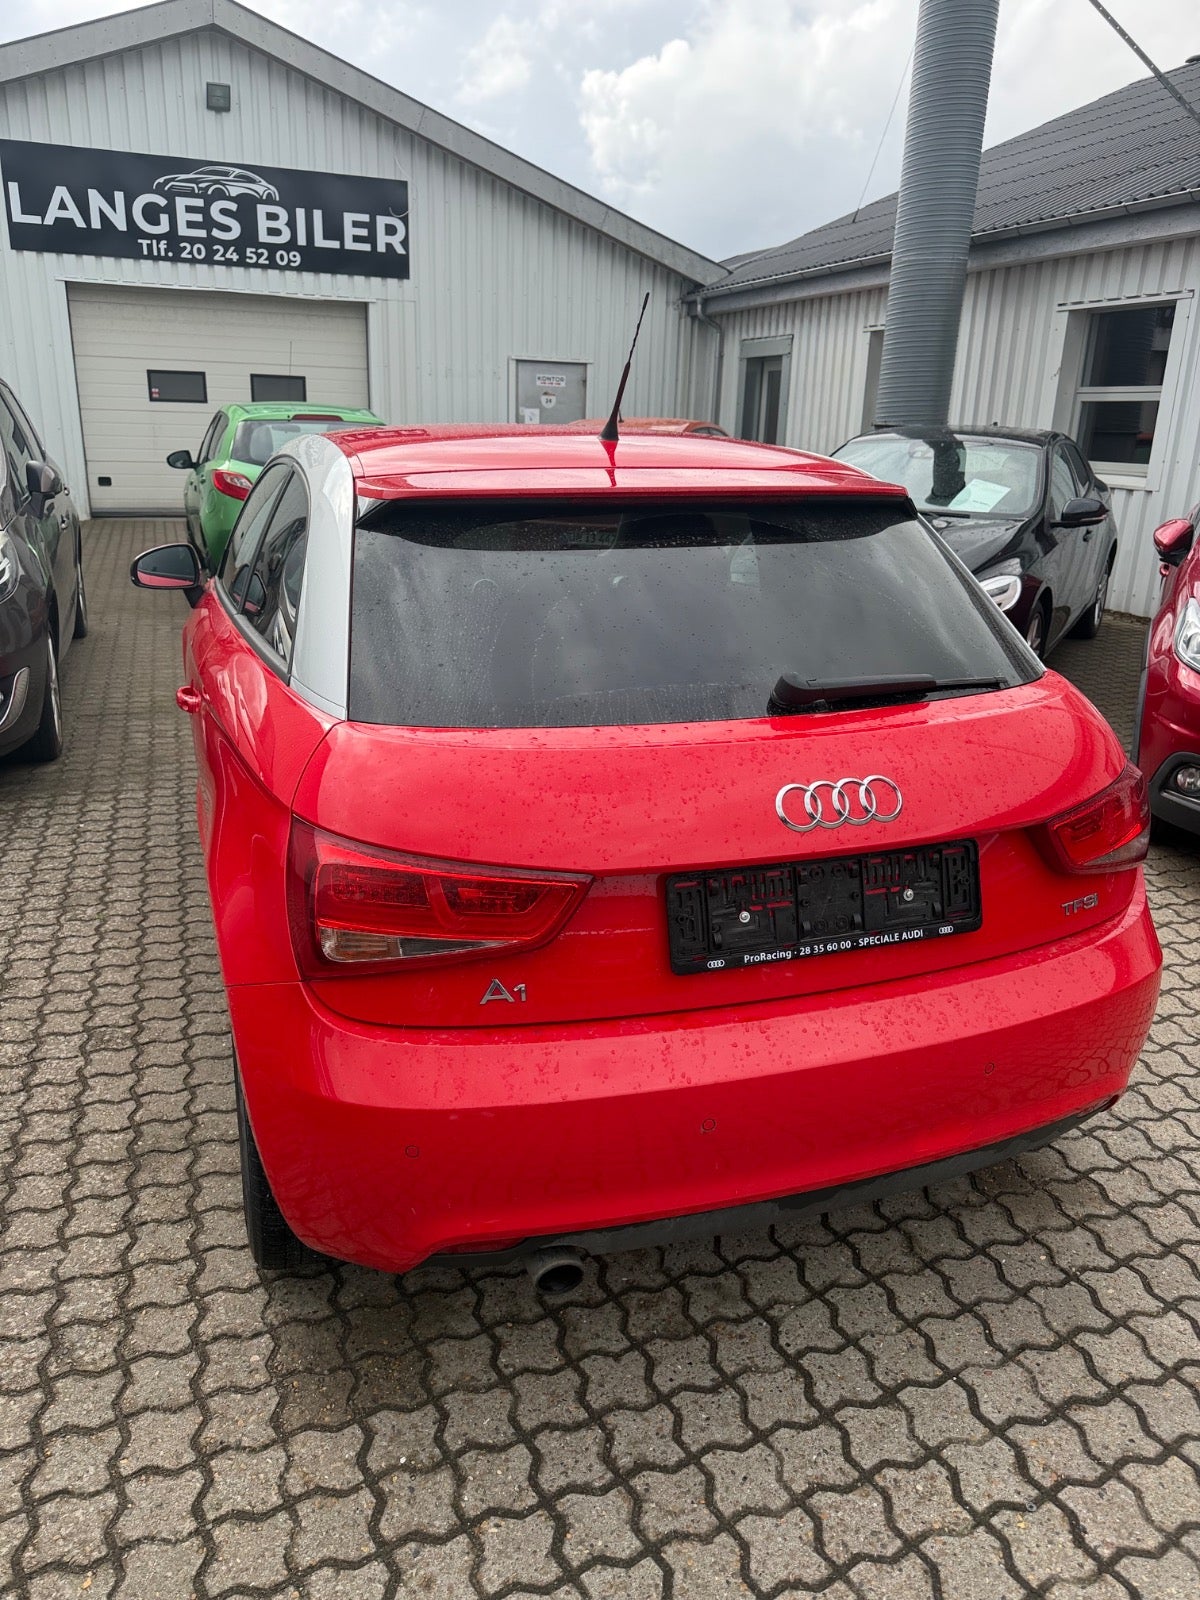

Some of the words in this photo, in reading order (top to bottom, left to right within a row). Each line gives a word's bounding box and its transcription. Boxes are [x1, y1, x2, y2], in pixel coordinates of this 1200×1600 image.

[8, 181, 242, 241] LANGES
[256, 203, 407, 255] BILER
[137, 239, 173, 257] Tlf.
[179, 242, 206, 260] 20
[212, 245, 239, 262] 24
[246, 247, 270, 265] 52
[275, 250, 301, 267] 09
[744, 950, 792, 964] ProRacing
[799, 946, 811, 956] 28
[814, 944, 825, 954] 35
[826, 942, 838, 952] 60
[840, 940, 851, 950] 00
[858, 932, 900, 947] SPECIALE
[901, 929, 923, 941] AUDI
[479, 978, 526, 1005] A1
